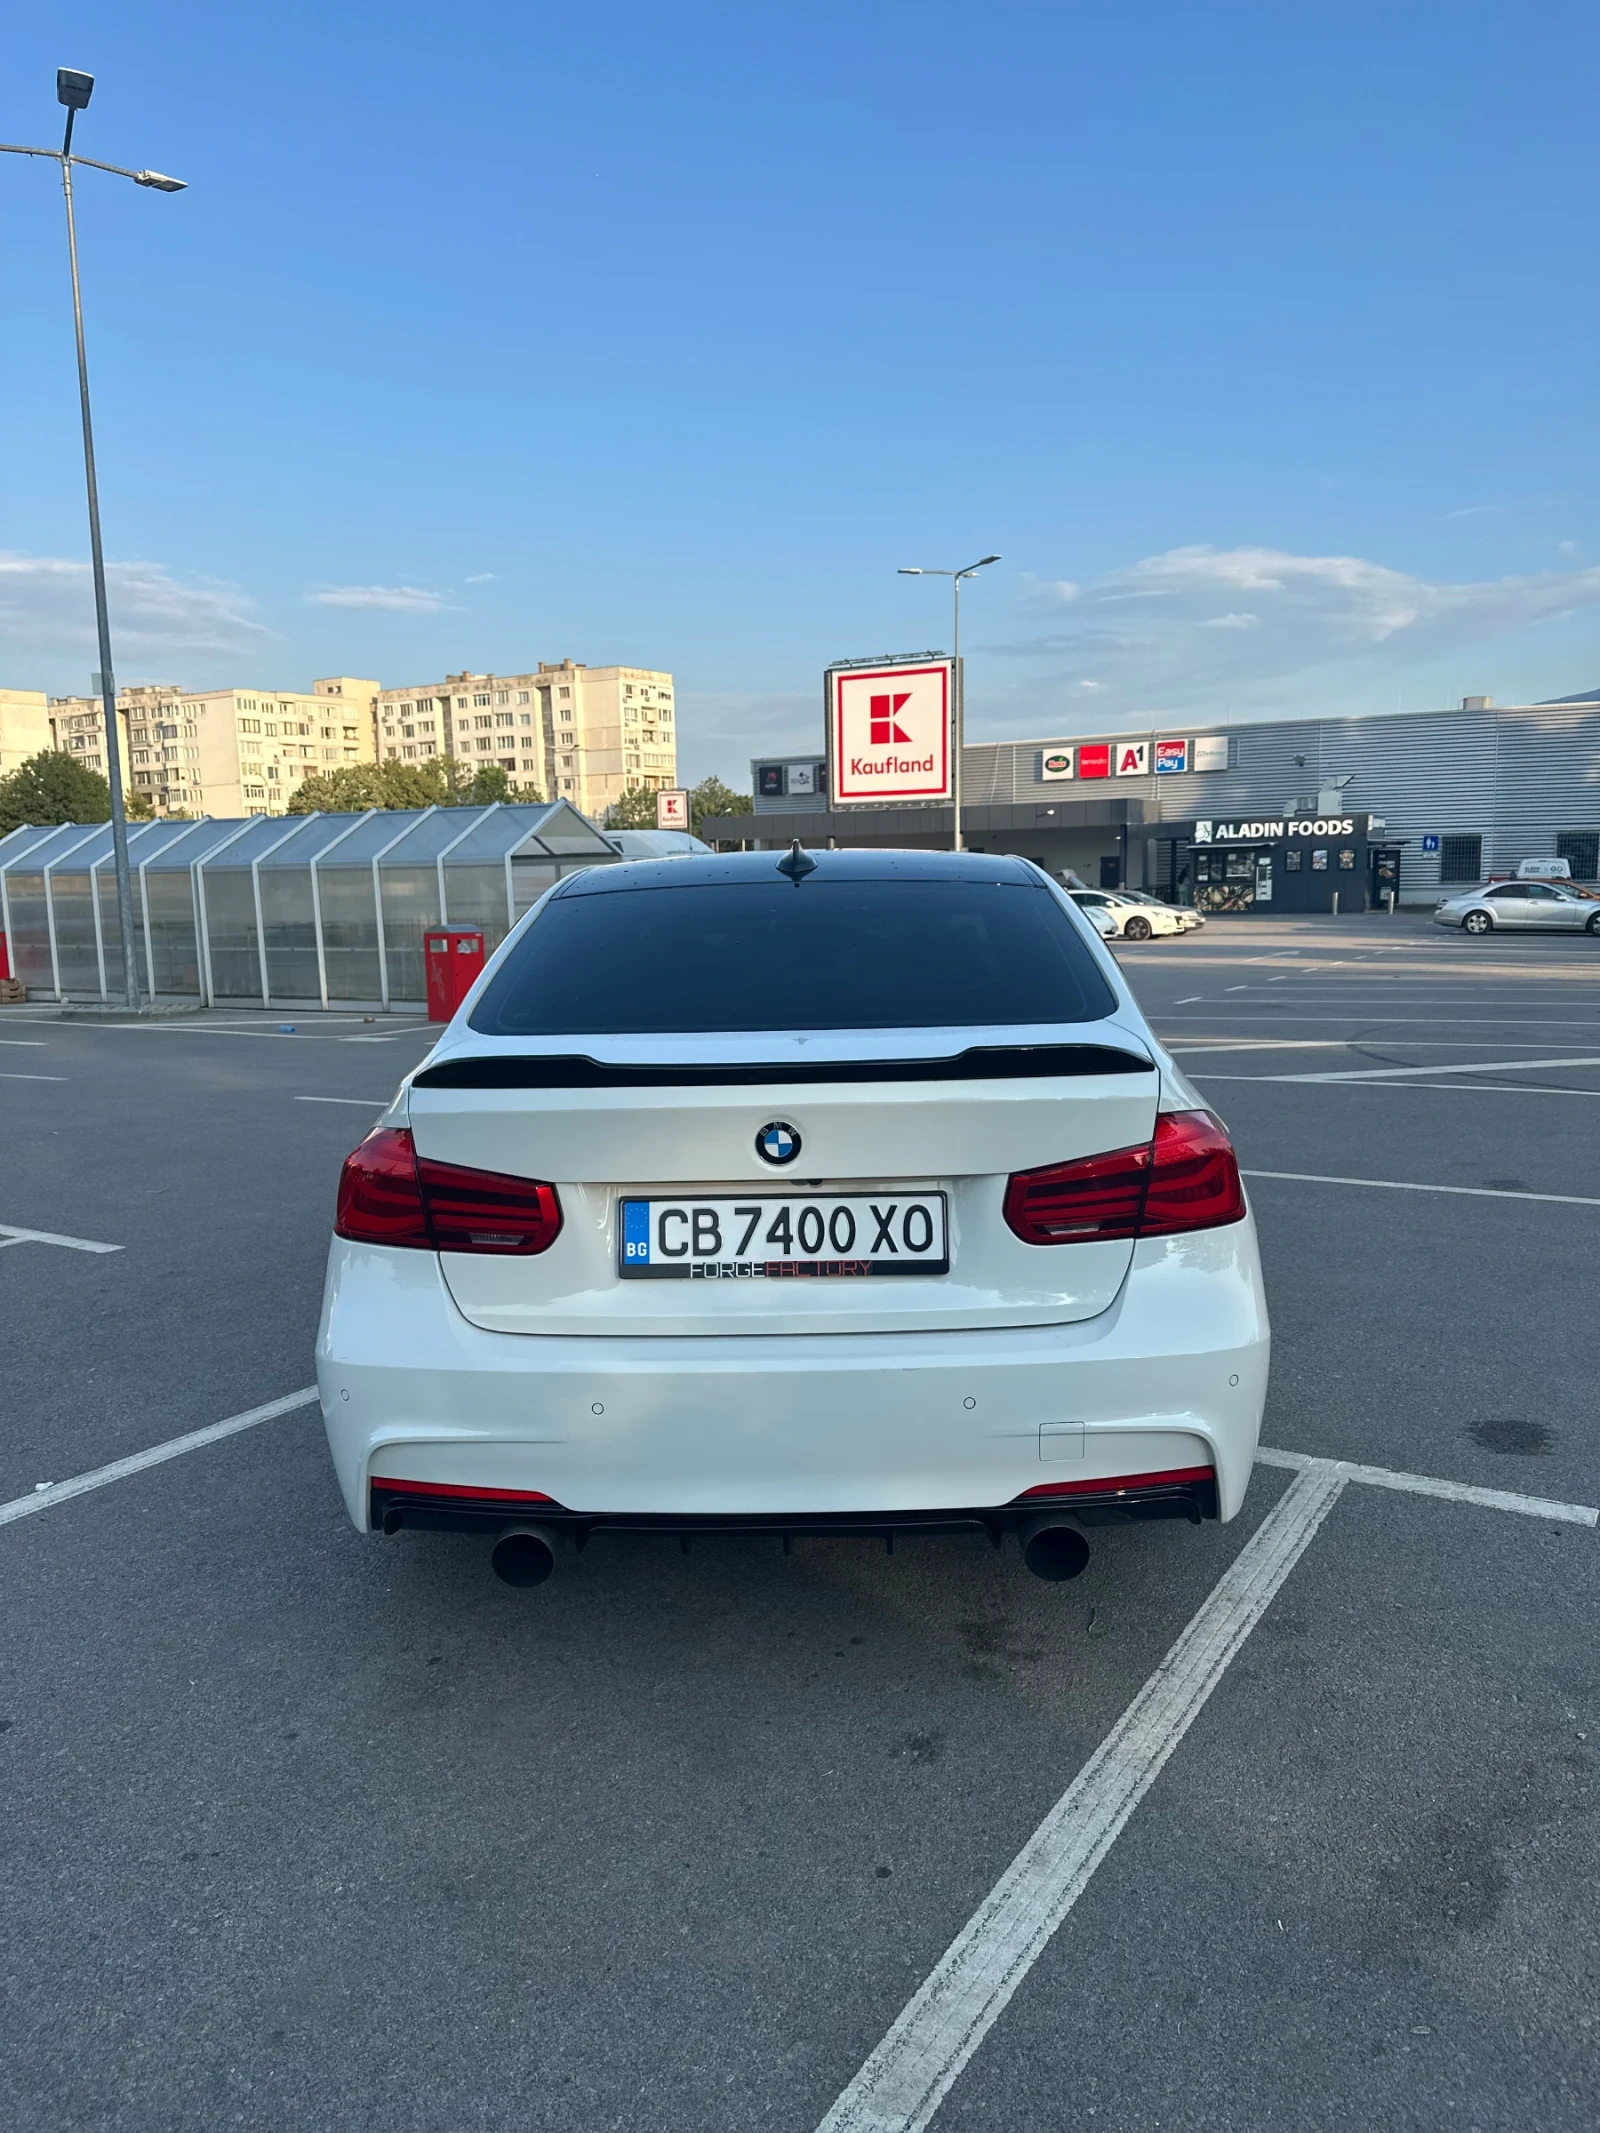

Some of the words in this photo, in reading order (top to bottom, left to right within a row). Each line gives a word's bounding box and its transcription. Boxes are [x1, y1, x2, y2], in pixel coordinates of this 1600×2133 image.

[1120, 745, 1144, 771] A1
[1157, 746, 1184, 758] Easy
[851, 754, 934, 775] Kaufland
[1157, 758, 1178, 769] Pay
[1215, 822, 1284, 839] ALADIN
[1288, 819, 1354, 836] FOODS
[760, 1122, 798, 1137] BMW
[658, 1208, 722, 1257] CB
[734, 1205, 856, 1256] 7400
[870, 1204, 933, 1253] XO
[626, 1242, 647, 1257] BG
